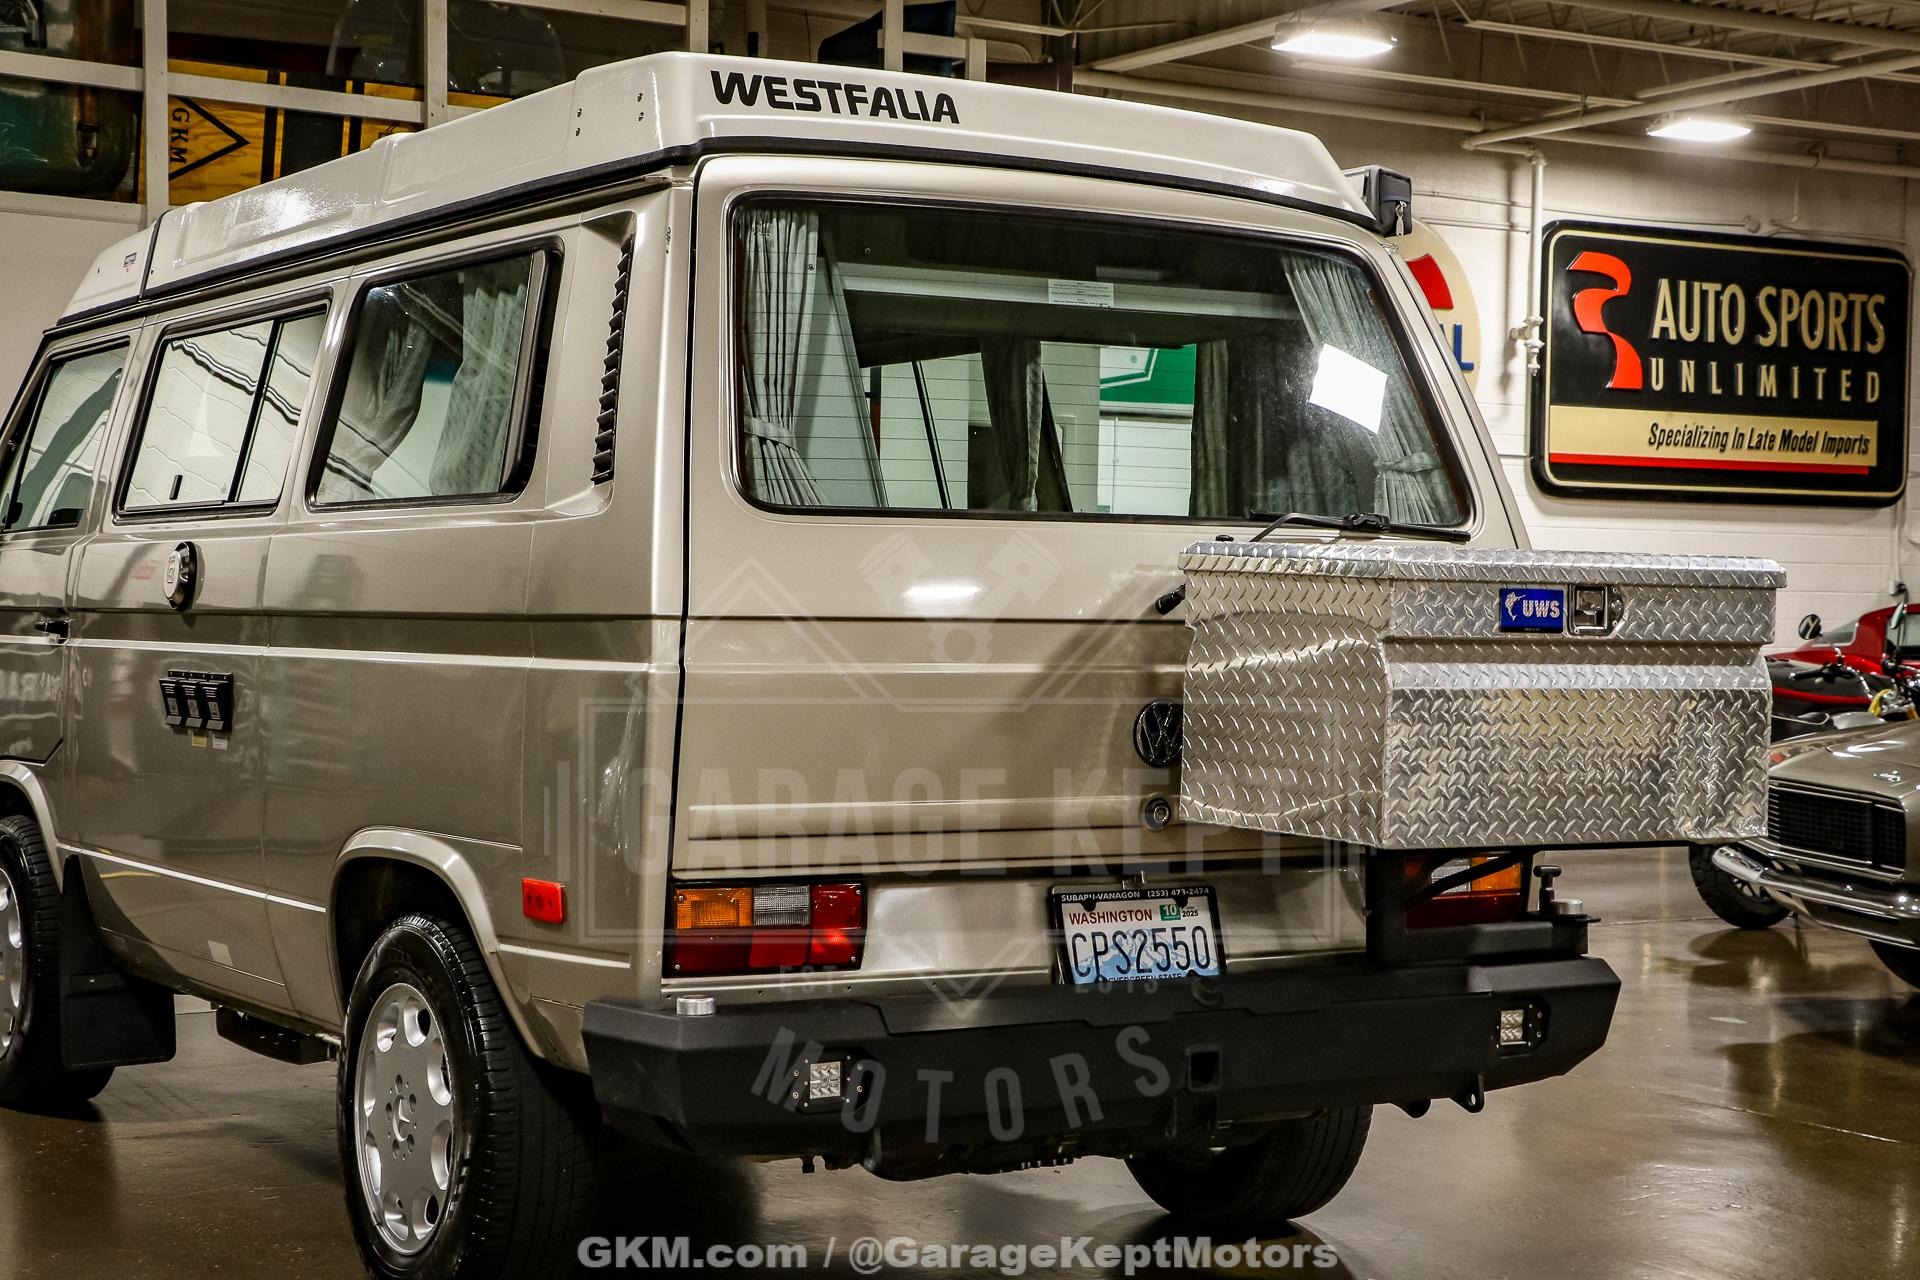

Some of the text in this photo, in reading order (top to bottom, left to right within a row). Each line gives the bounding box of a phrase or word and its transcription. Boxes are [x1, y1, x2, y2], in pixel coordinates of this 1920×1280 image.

[710, 70, 960, 124] WESTFALIA
[169, 107, 190, 164] GKM
[1651, 278, 1886, 354] AUTO SPORTS
[1650, 357, 1881, 404] UNLIMITED
[1648, 422, 1871, 457] Specializing In Late Model Imports
[1522, 599, 1561, 618] UWS
[1069, 903, 1199, 925] WASHINGTON 10 2025
[1147, 889, 1169, 898] (253)
[1071, 925, 1211, 979] CPS2550
